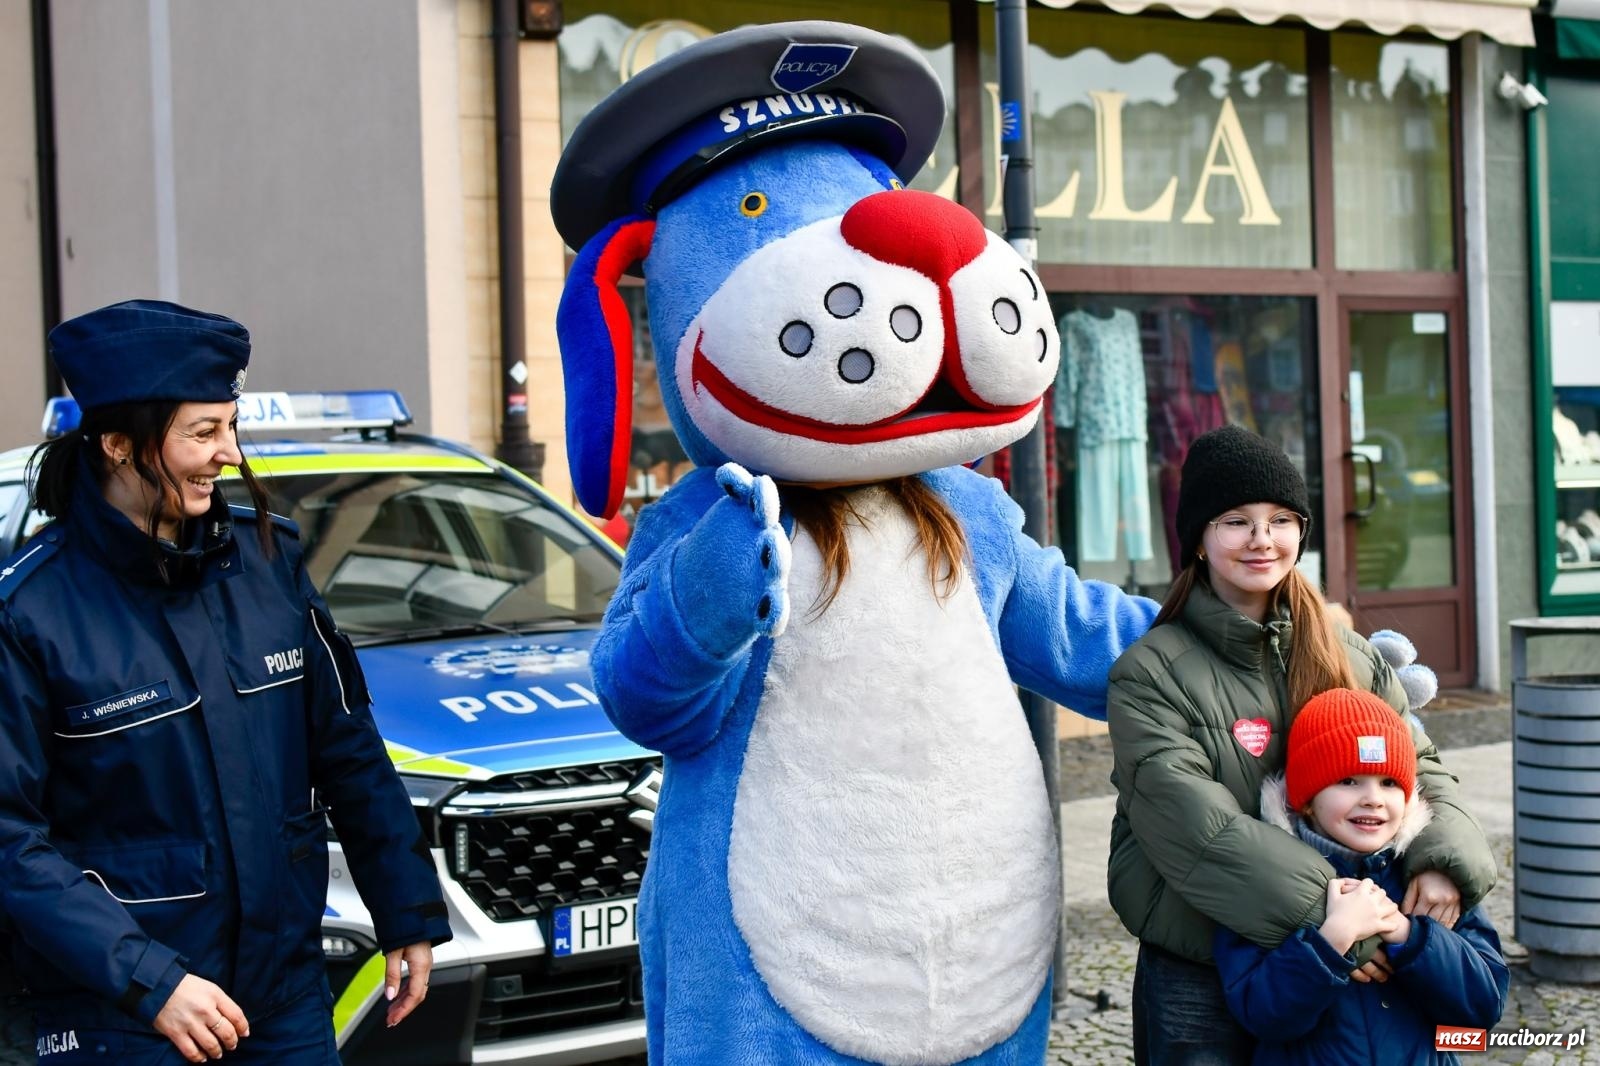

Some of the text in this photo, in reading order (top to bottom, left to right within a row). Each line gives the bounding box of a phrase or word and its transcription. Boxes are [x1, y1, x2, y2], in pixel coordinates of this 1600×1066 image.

[779, 62, 838, 76] POLICJA
[82, 689, 159, 720] J. WIŚNIEWSKA
[439, 683, 600, 723] POLI
[581, 903, 638, 949] HP
[555, 937, 570, 950] PL
